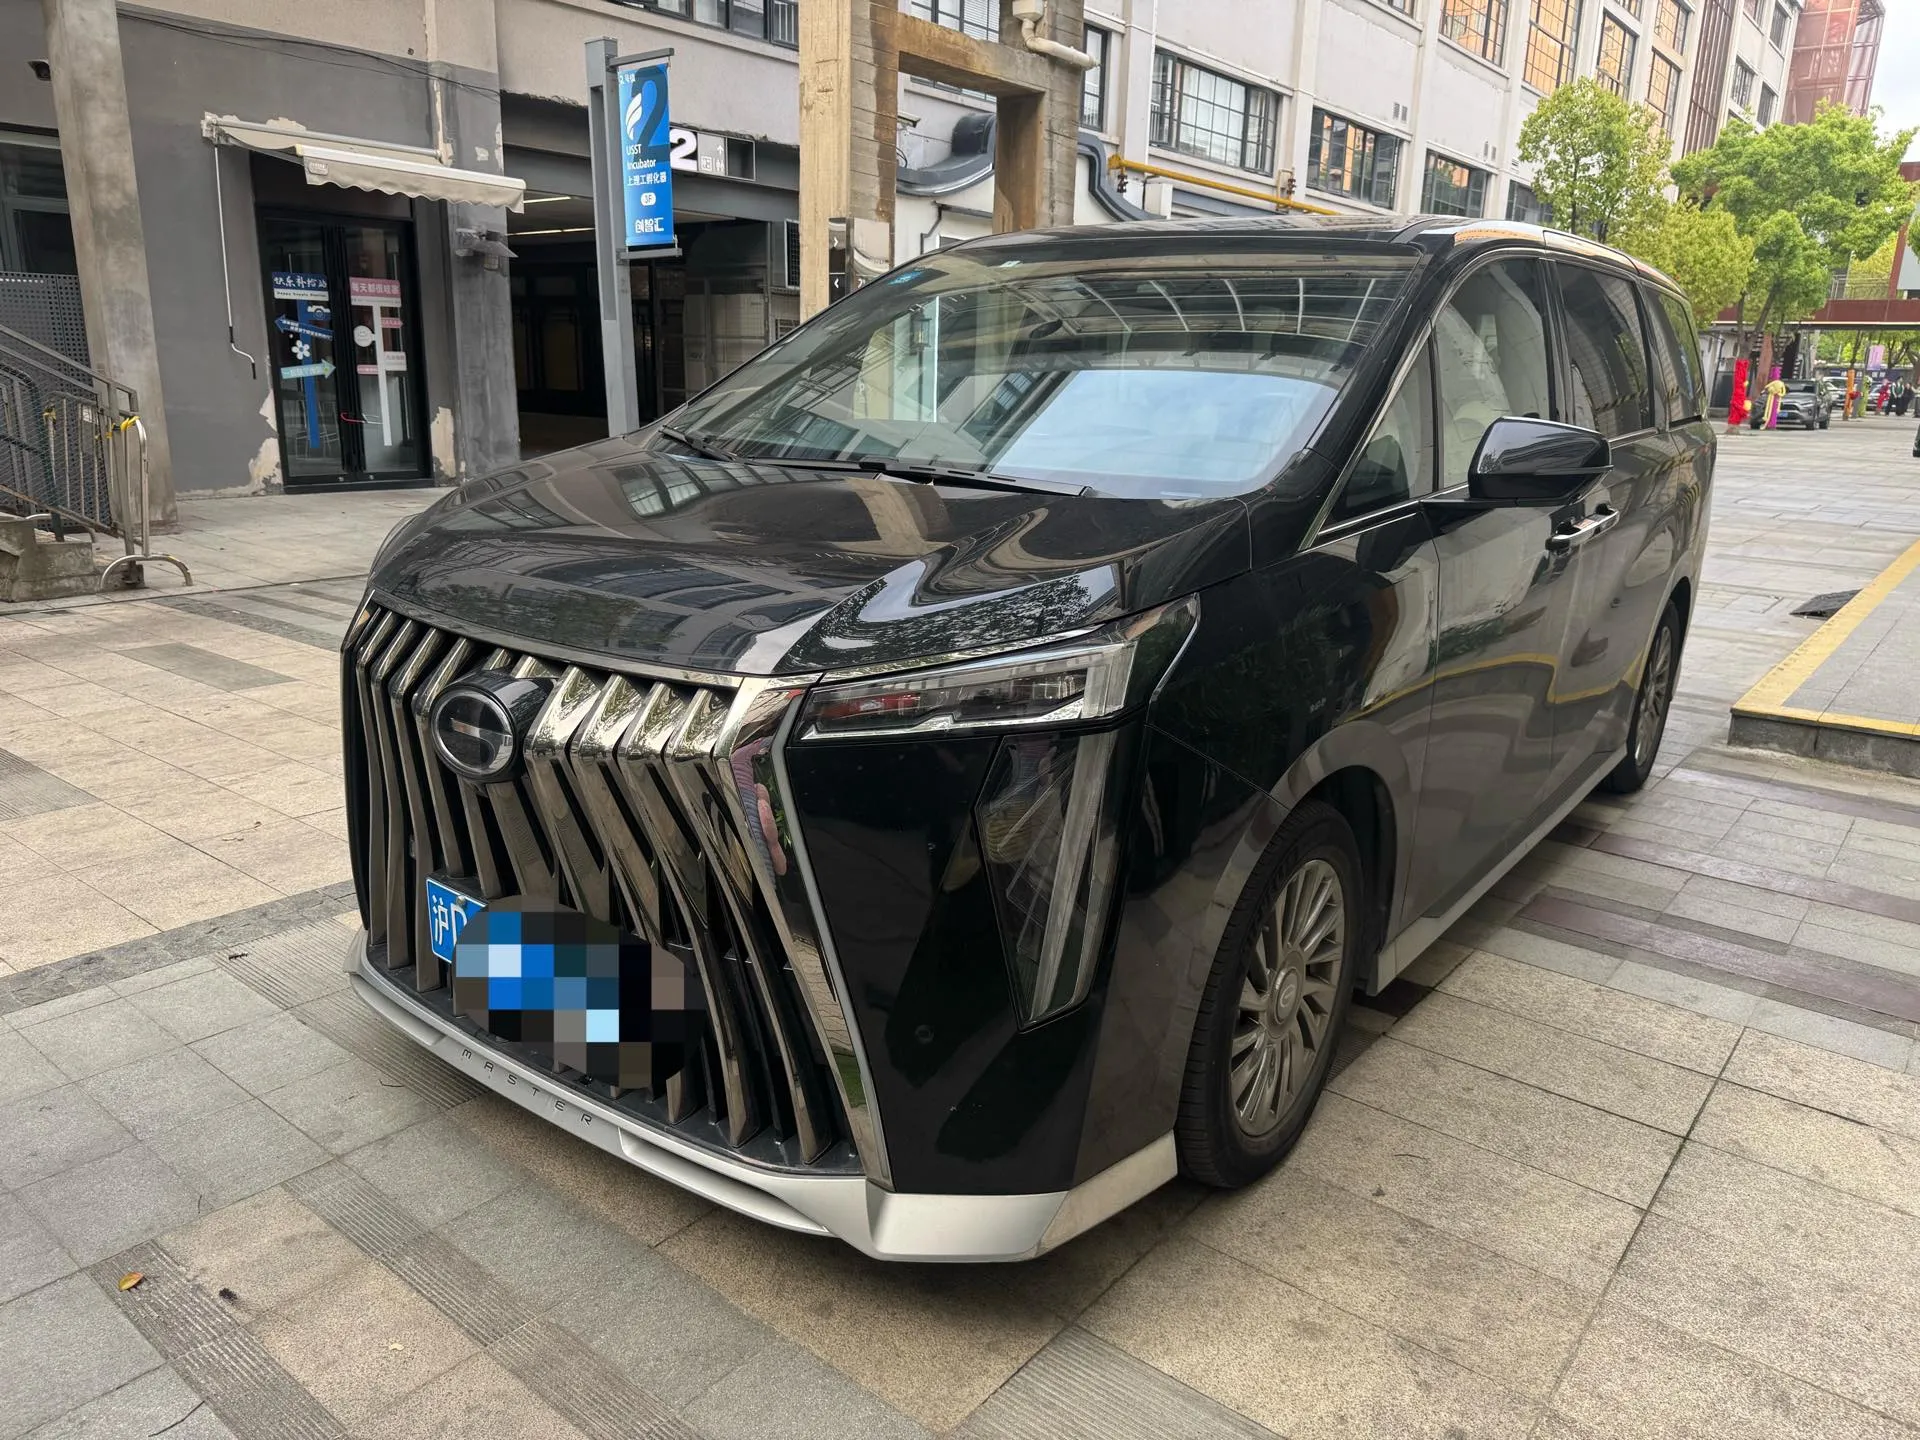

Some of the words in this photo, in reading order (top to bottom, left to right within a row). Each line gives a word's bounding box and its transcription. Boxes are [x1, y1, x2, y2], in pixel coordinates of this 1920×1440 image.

[626, 144, 642, 155] USST
[669, 128, 697, 171] 2
[627, 158, 656, 170] Incubator
[627, 171, 667, 186] 上理工孵化器
[635, 217, 665, 233] 创智汇
[461, 1049, 593, 1126] MASTER
